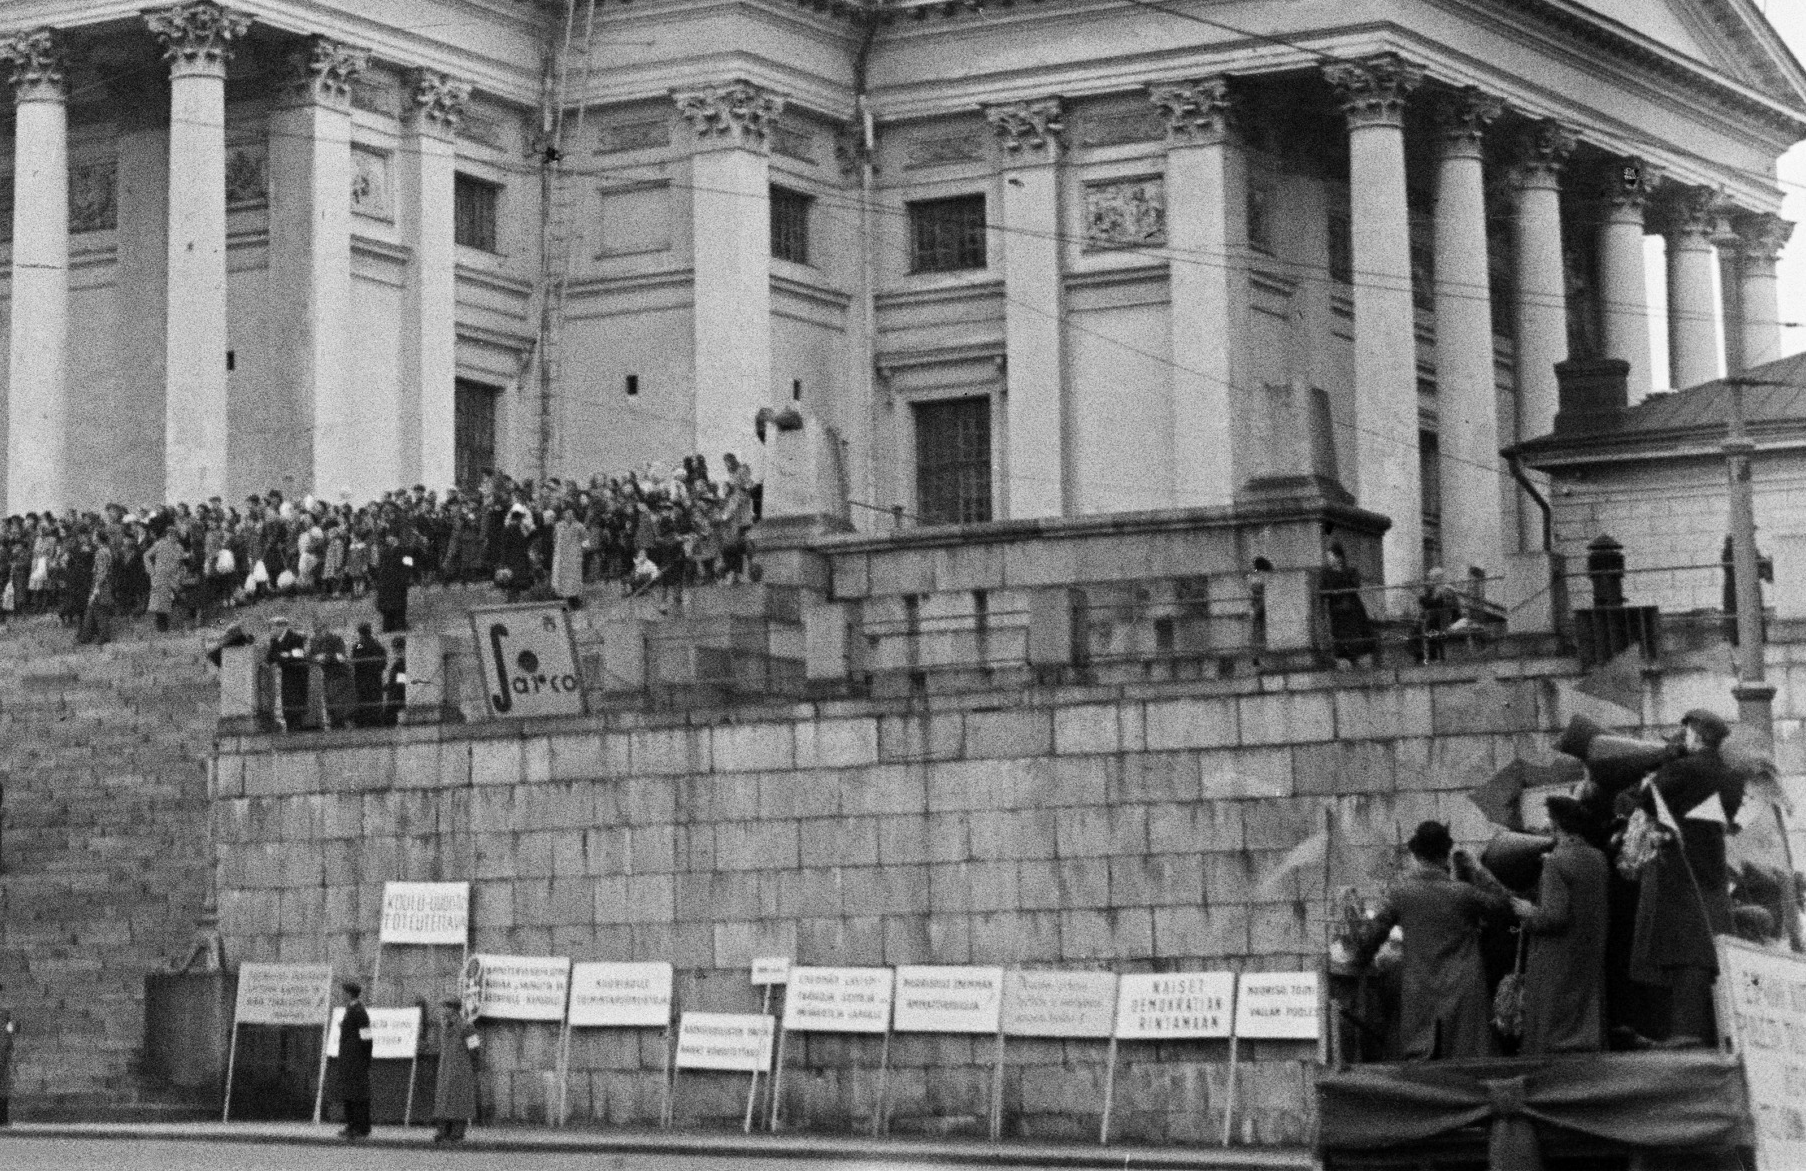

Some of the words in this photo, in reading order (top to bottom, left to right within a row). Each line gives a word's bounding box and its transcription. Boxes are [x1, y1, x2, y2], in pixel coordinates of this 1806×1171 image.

[1152, 978, 1205, 994] NAISET
[1130, 996, 1223, 1013] DEMOKRATIAN
[1138, 1015, 1219, 1031] RINTAMAAN
